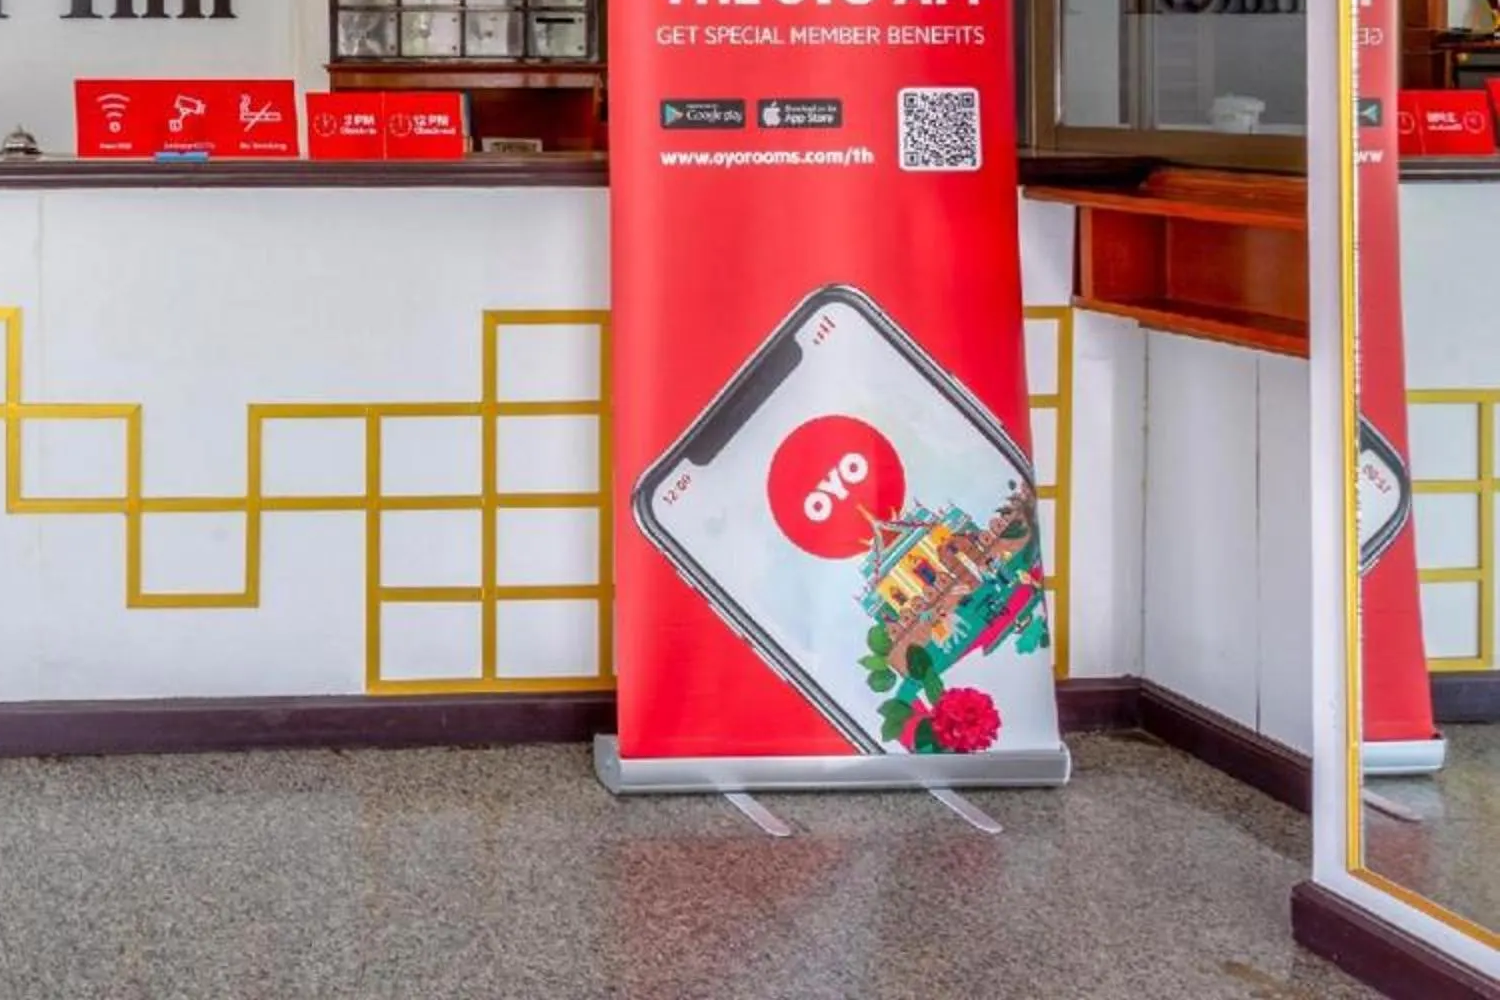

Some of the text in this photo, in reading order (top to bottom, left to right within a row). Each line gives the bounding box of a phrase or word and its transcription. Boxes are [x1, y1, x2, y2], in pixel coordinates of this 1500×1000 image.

[657, 25, 986, 46] GET SPECIAL MEMBER BENEFITS
[784, 112, 835, 125] App Store
[660, 147, 876, 168] www.oyorooms.com/th
[803, 452, 869, 523] OYO
